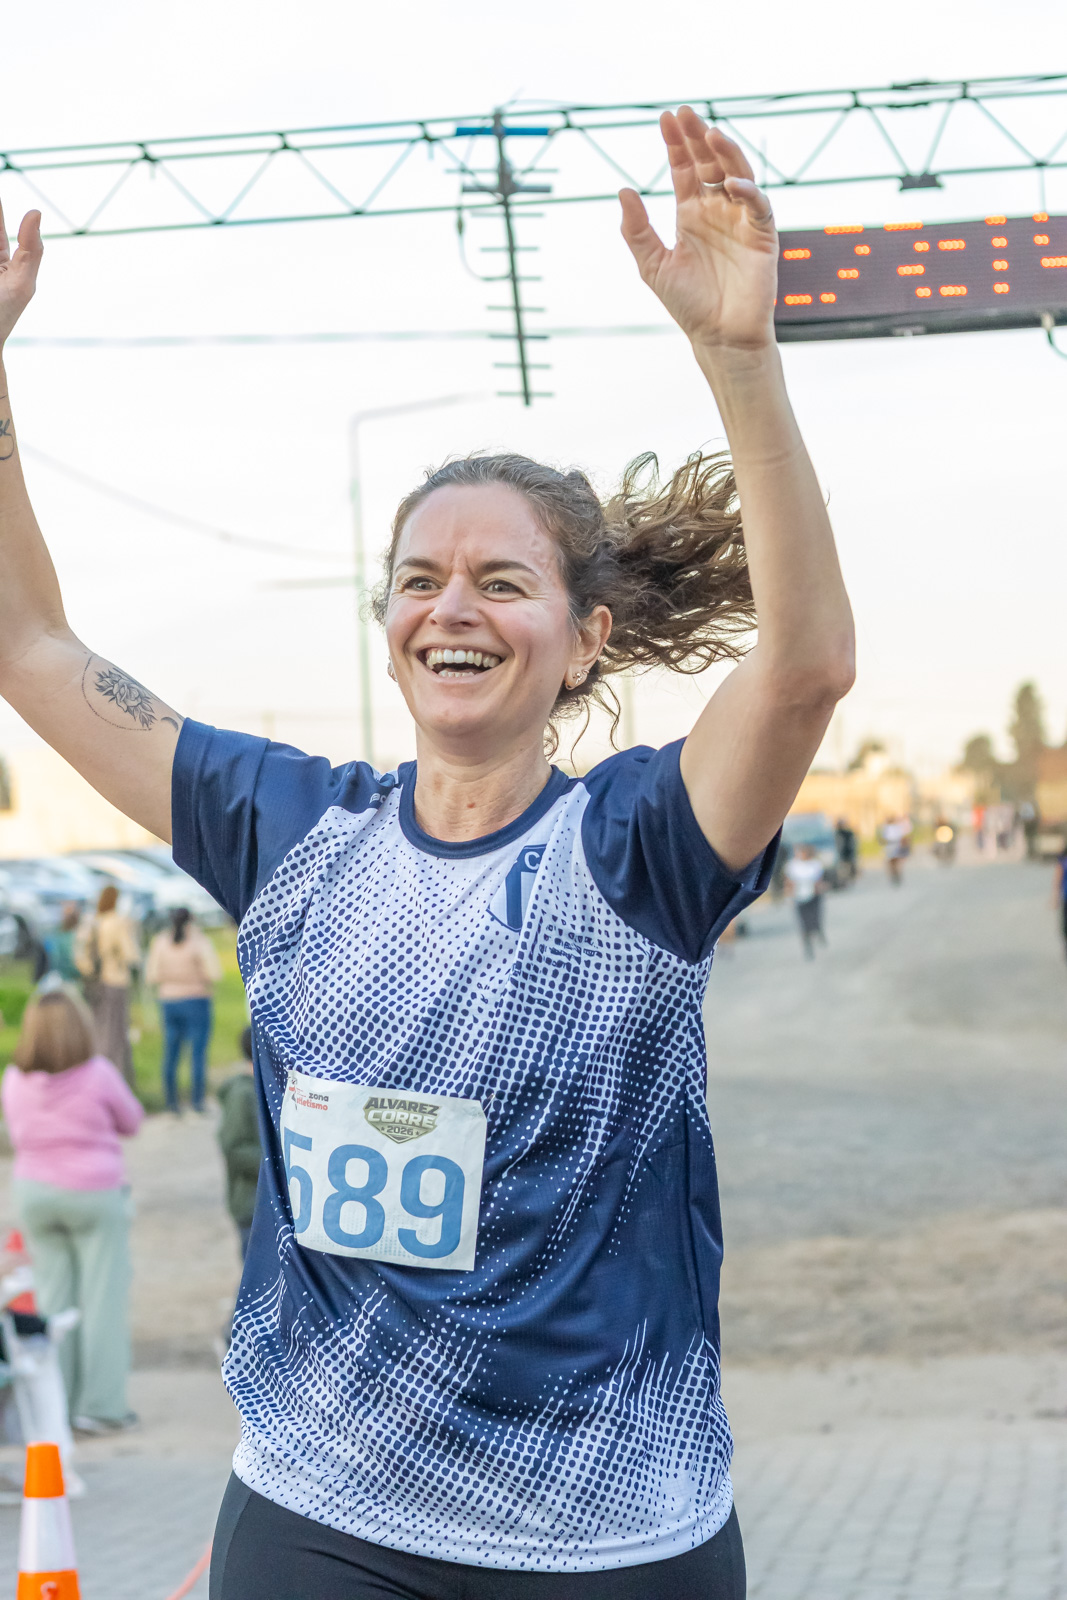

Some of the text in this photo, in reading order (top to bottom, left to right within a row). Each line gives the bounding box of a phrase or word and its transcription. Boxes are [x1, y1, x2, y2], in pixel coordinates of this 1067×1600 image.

[296, 1097, 328, 1111] tletismo
[308, 1092, 329, 1102] zona
[364, 1097, 440, 1116] ALVAREZ
[367, 1109, 436, 1129] CORRE
[386, 1125, 414, 1136] 2026
[283, 1126, 466, 1260] 589
